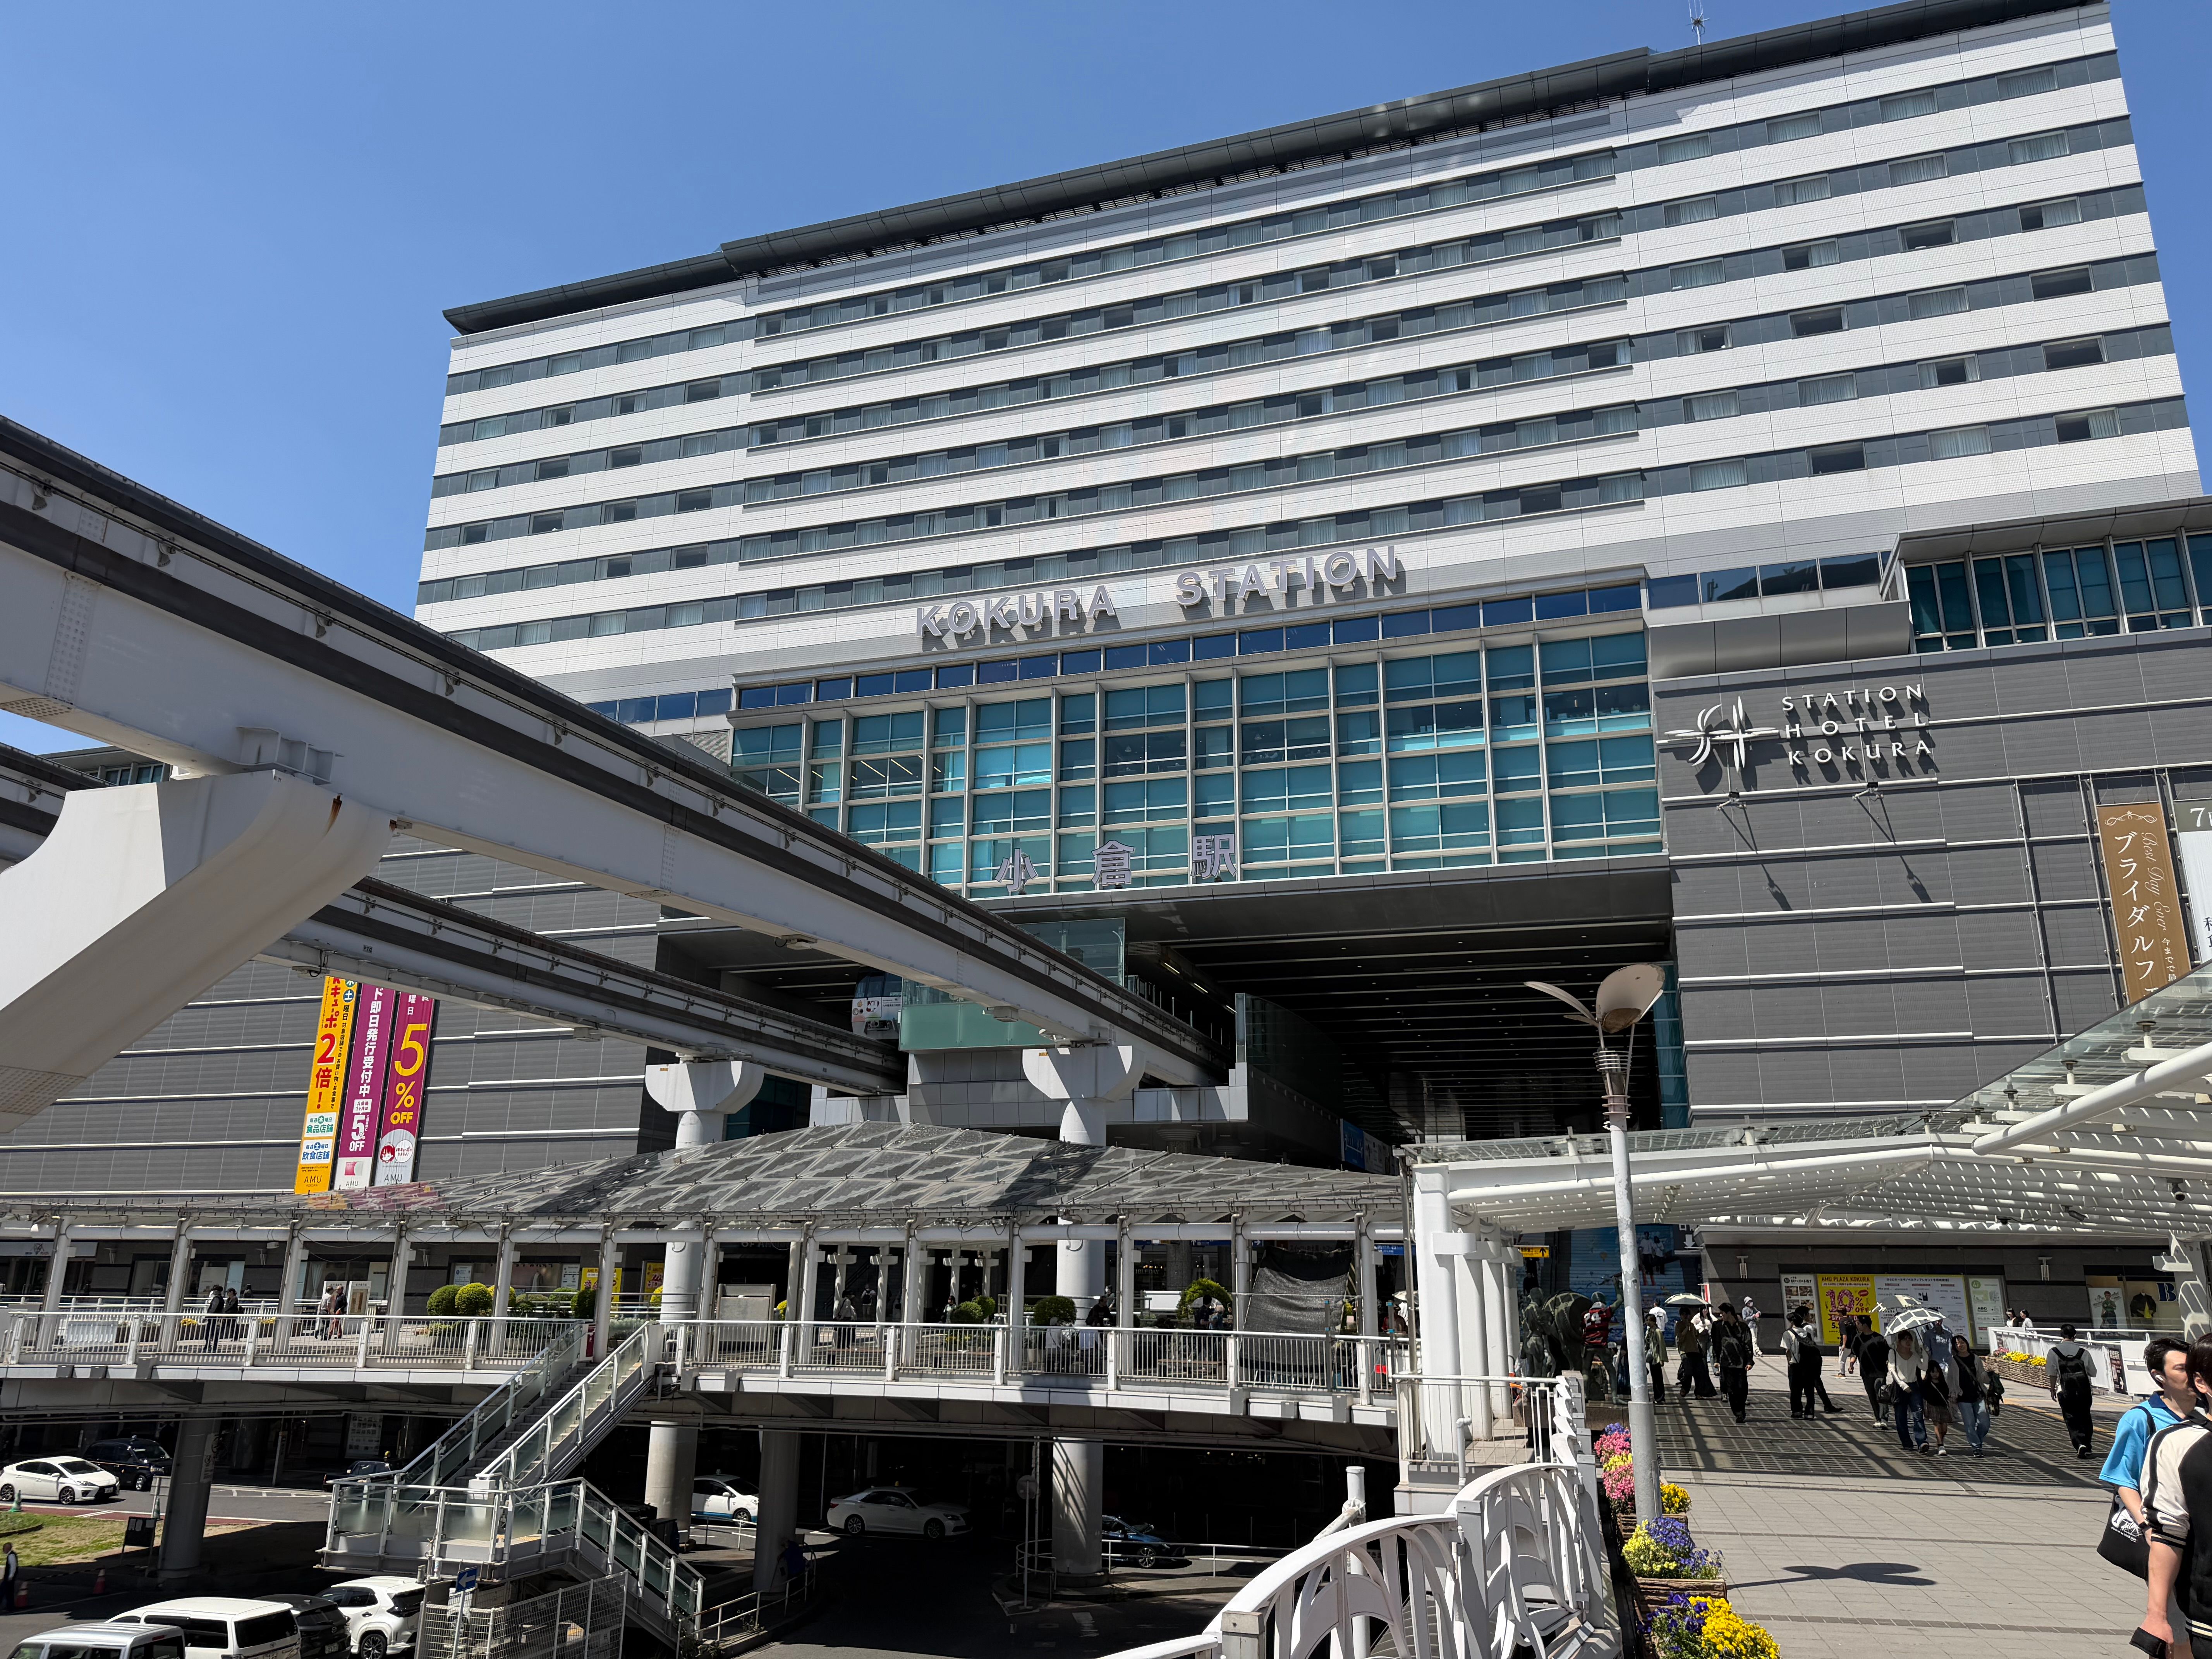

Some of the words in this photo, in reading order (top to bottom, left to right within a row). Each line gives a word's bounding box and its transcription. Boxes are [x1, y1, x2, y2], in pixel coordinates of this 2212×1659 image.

[916, 585, 1115, 638] KOKURA
[1176, 546, 1397, 606] STATION
[1782, 684, 1922, 712] STATION
[1785, 713, 1927, 739] HOTEL
[1788, 740, 1931, 765] KOKURA
[2141, 832, 2159, 863] Best
[994, 834, 1237, 891] 小倉駅
[2145, 867, 2166, 898] Day
[2154, 901, 2171, 931] Ever
[306, 1124, 333, 1133] 食品店舗
[390, 1111, 414, 1124] OFF
[302, 1151, 330, 1160] 飲食店舗
[349, 1141, 365, 1152] OFF
[304, 1175, 322, 1183] AMU
